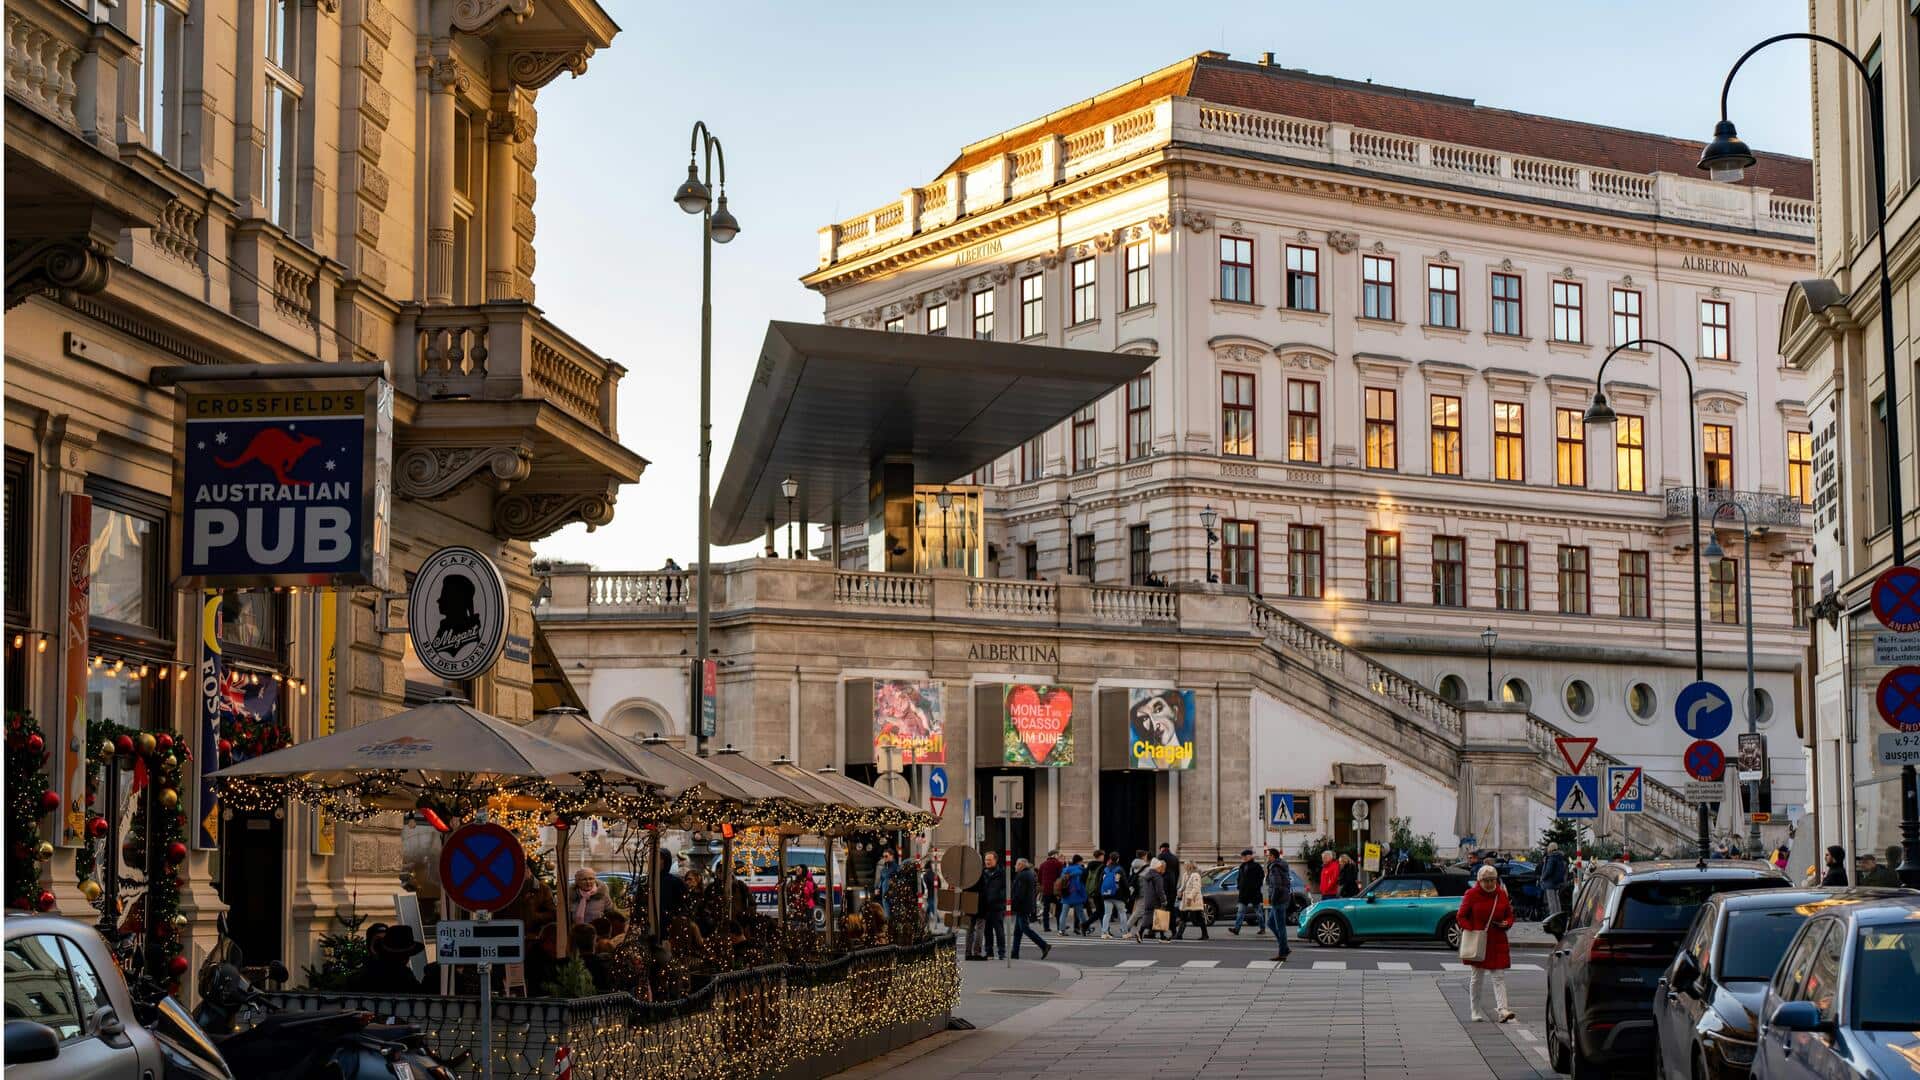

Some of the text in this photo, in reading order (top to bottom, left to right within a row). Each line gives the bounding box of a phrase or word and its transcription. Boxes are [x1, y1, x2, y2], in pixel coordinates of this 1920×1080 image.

[955, 239, 1003, 267] ALBERTINA
[1681, 255, 1749, 278] ALBERTINA
[197, 395, 356, 414] CROSSFIELD'S
[195, 482, 350, 503] AUSTRALIAN
[192, 506, 352, 566] PUB
[432, 624, 479, 649] Mozart
[423, 641, 437, 663] BEI
[437, 660, 458, 671] DER
[461, 642, 487, 670] OPER
[968, 643, 1058, 662] ALBERTINA
[1010, 703, 1052, 717] MONET
[1010, 716, 1061, 730] PICASSO
[1015, 731, 1064, 744] JIM DINE
[1133, 740, 1193, 765] Chagall
[459, 927, 471, 937] ab
[482, 945, 497, 958] bis
